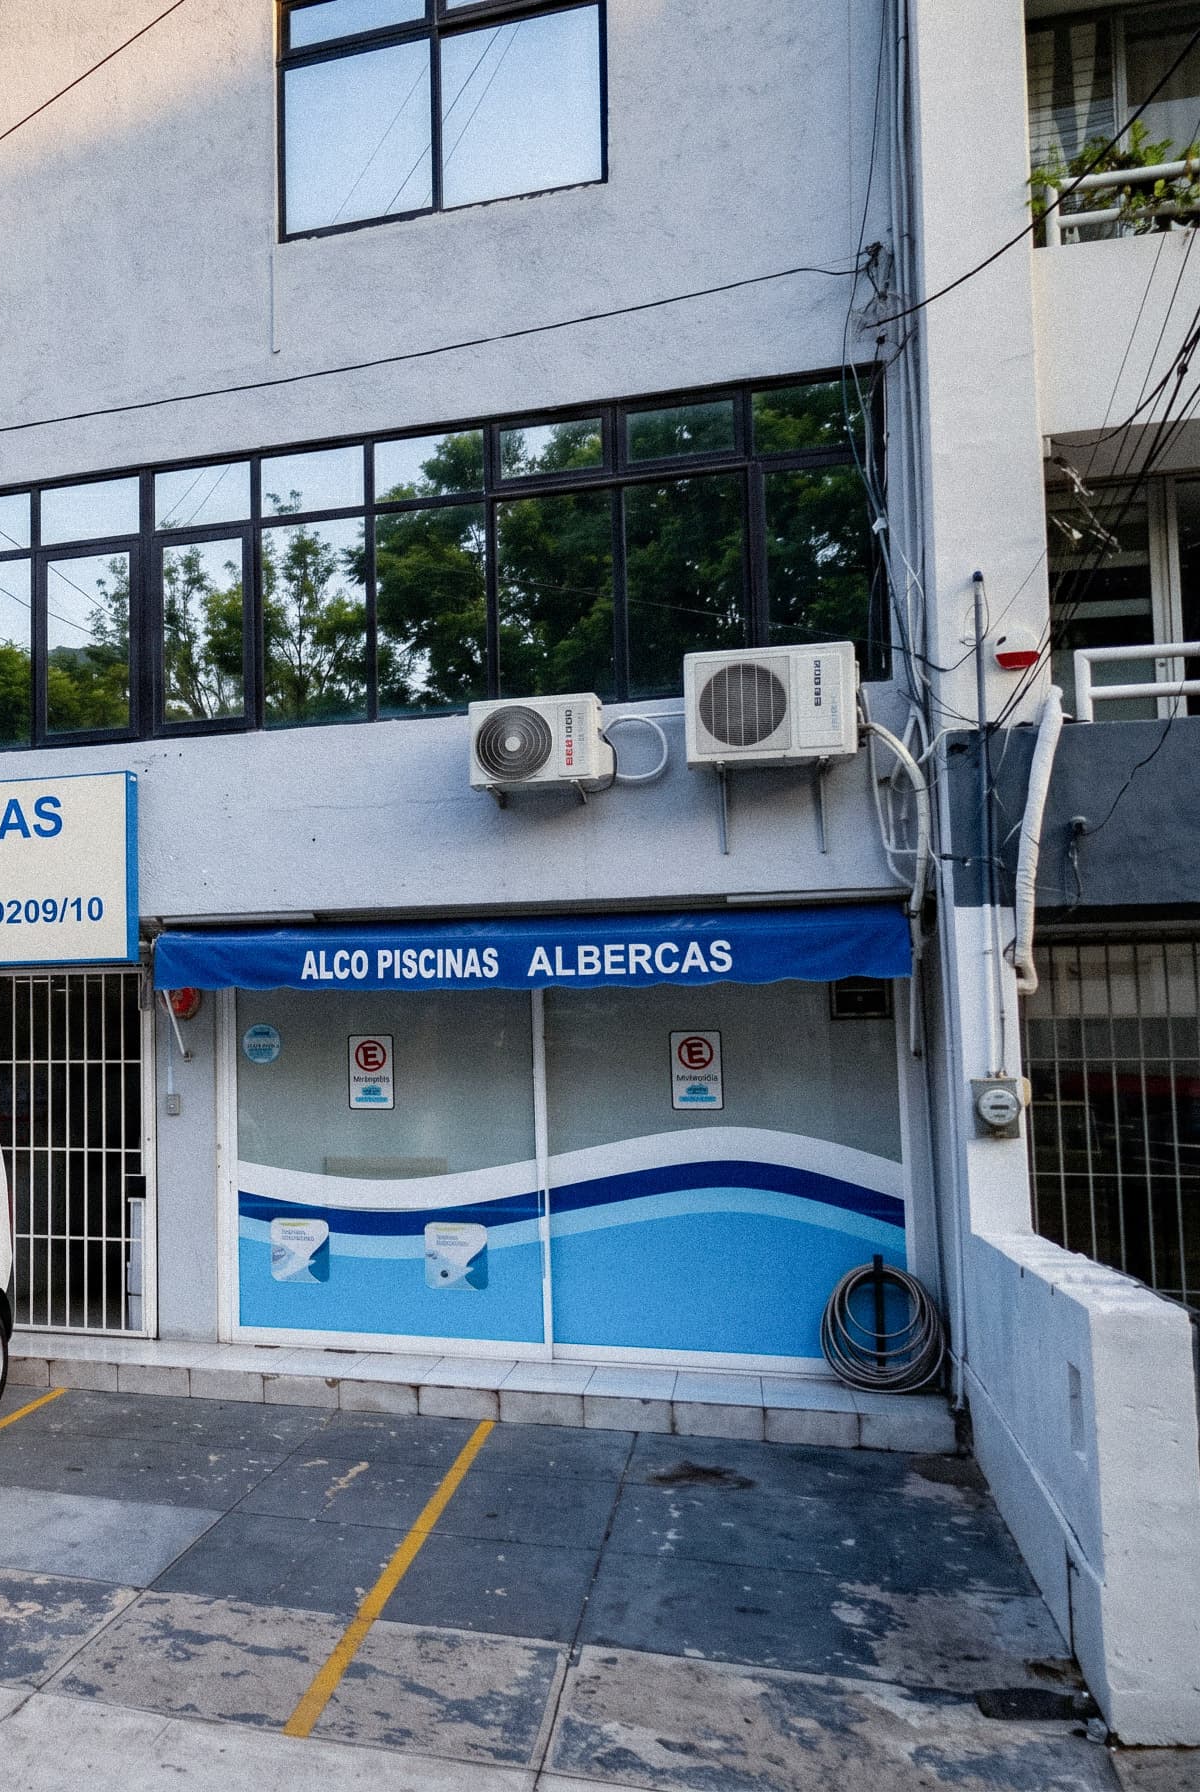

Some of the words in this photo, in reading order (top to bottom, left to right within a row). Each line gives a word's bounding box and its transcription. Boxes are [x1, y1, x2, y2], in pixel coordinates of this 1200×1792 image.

[301, 949, 370, 981] ALCO
[377, 947, 500, 980] PISCINAS
[527, 939, 734, 977] ALBERCAS
